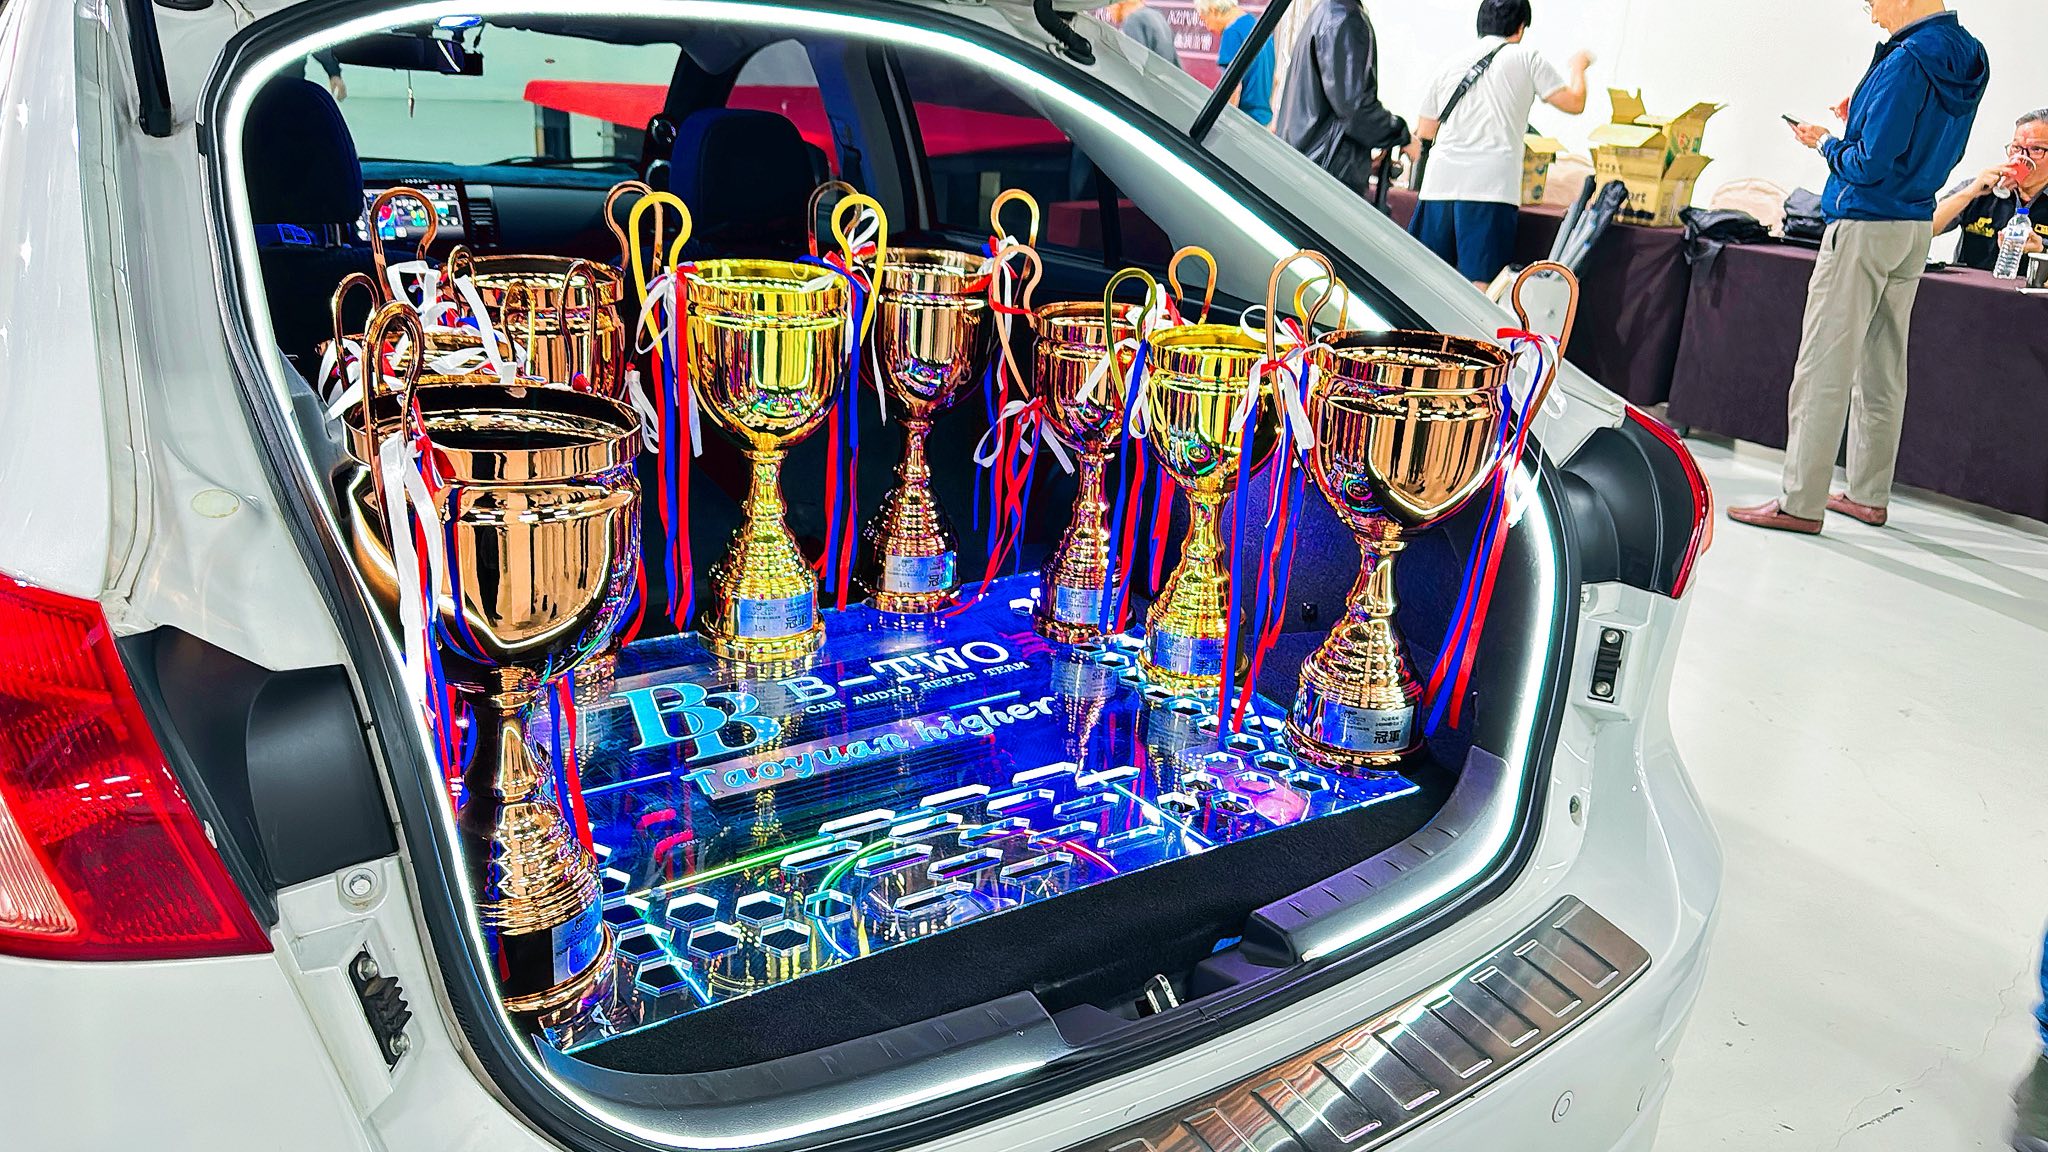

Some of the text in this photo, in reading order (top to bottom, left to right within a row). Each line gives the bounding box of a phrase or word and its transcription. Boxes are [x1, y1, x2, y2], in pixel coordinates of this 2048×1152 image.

[899, 580, 911, 589] 1st
[1066, 609, 1081, 619] 2nd
[754, 624, 767, 632] 1st
[804, 661, 1031, 714] CAR AUDIO REFIT TEAM
[1373, 730, 1401, 744] 冠軍
[680, 696, 1056, 796] Taoyuan higher
[574, 949, 589, 964] 1st
